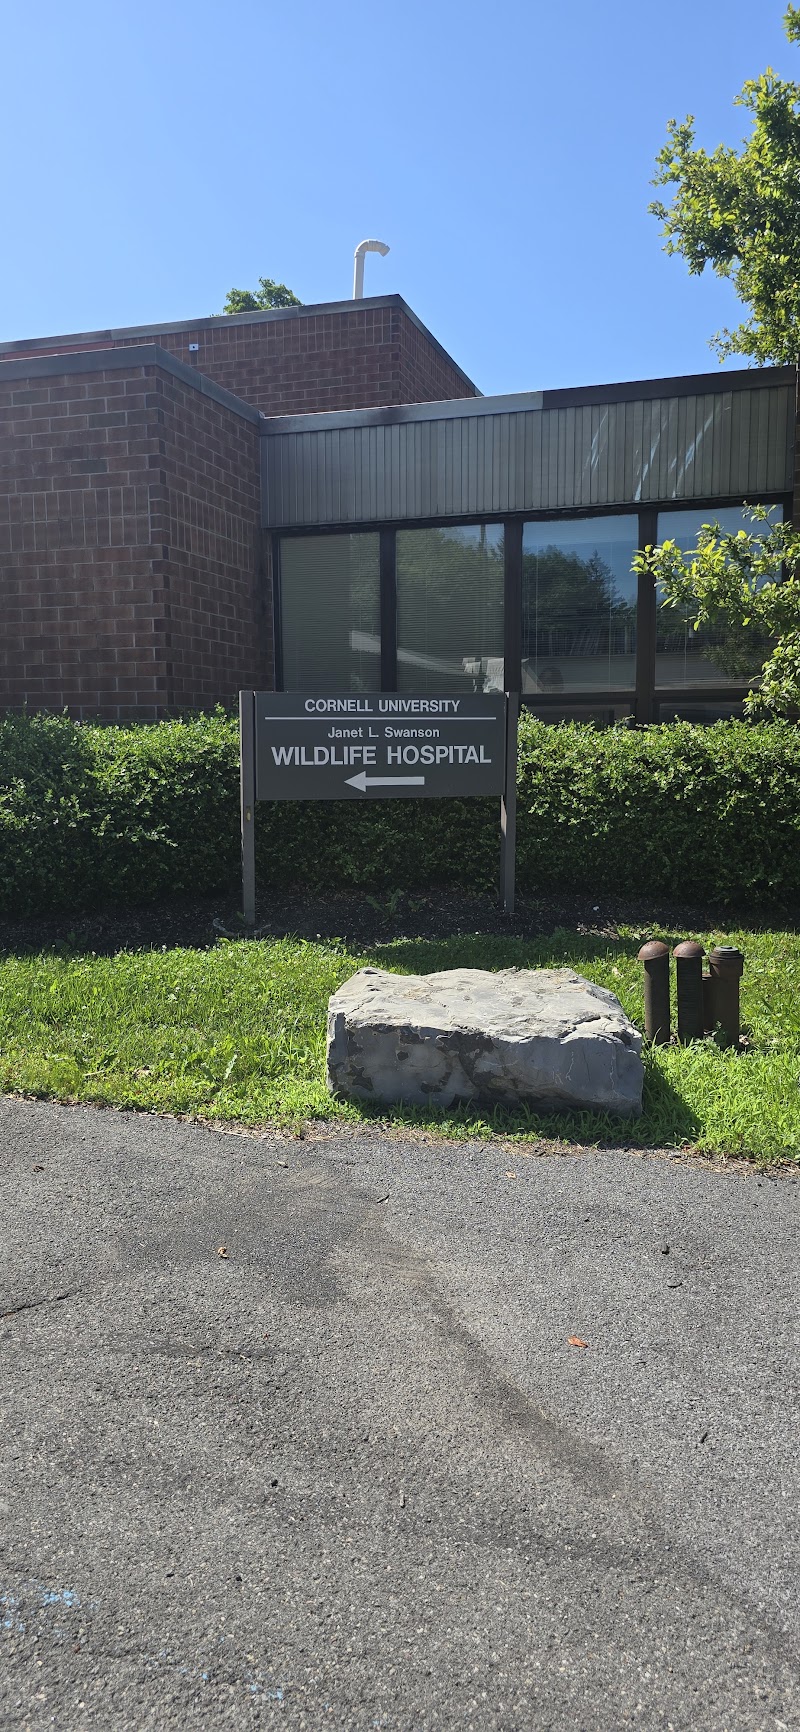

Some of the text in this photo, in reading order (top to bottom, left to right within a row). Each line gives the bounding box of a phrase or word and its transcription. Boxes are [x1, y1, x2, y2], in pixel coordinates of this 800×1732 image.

[304, 699, 460, 712] CORNELL UNIVERSITY
[327, 727, 440, 738] Janet L. Swanson
[271, 745, 492, 765] WILDLIFE HOSPITAL
